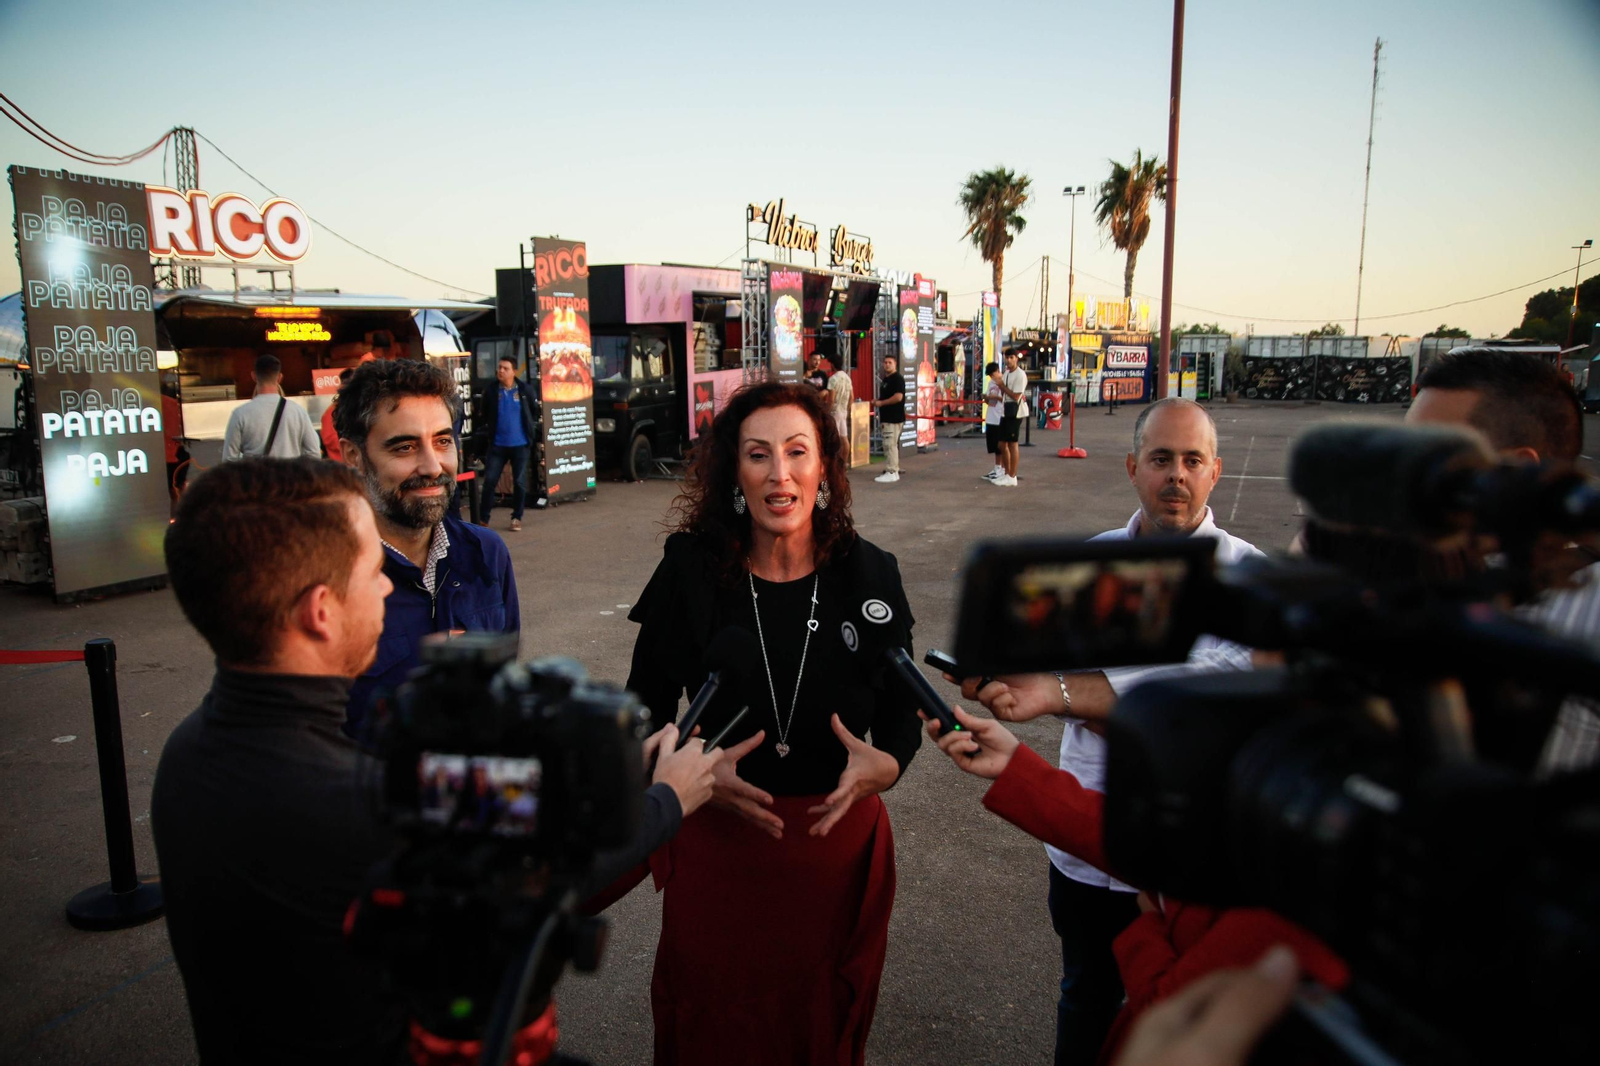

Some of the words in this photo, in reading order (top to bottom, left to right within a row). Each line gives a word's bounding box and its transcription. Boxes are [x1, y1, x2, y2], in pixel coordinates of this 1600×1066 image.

[42, 195, 127, 230] PAJA
[147, 190, 311, 259] RICO
[22, 213, 148, 250] PATATA
[833, 224, 874, 276] Burger
[535, 245, 588, 288] RICO
[28, 280, 153, 312] PATATA
[538, 296, 590, 312] TRUFADA
[54, 325, 137, 354] PAJA
[1016, 329, 1040, 341] GUINNESS
[35, 346, 157, 374] PATATA
[1110, 350, 1147, 363] YBARRA
[60, 387, 142, 415] PAJA
[42, 407, 162, 439] PATATA
[67, 449, 148, 478] PAJA
